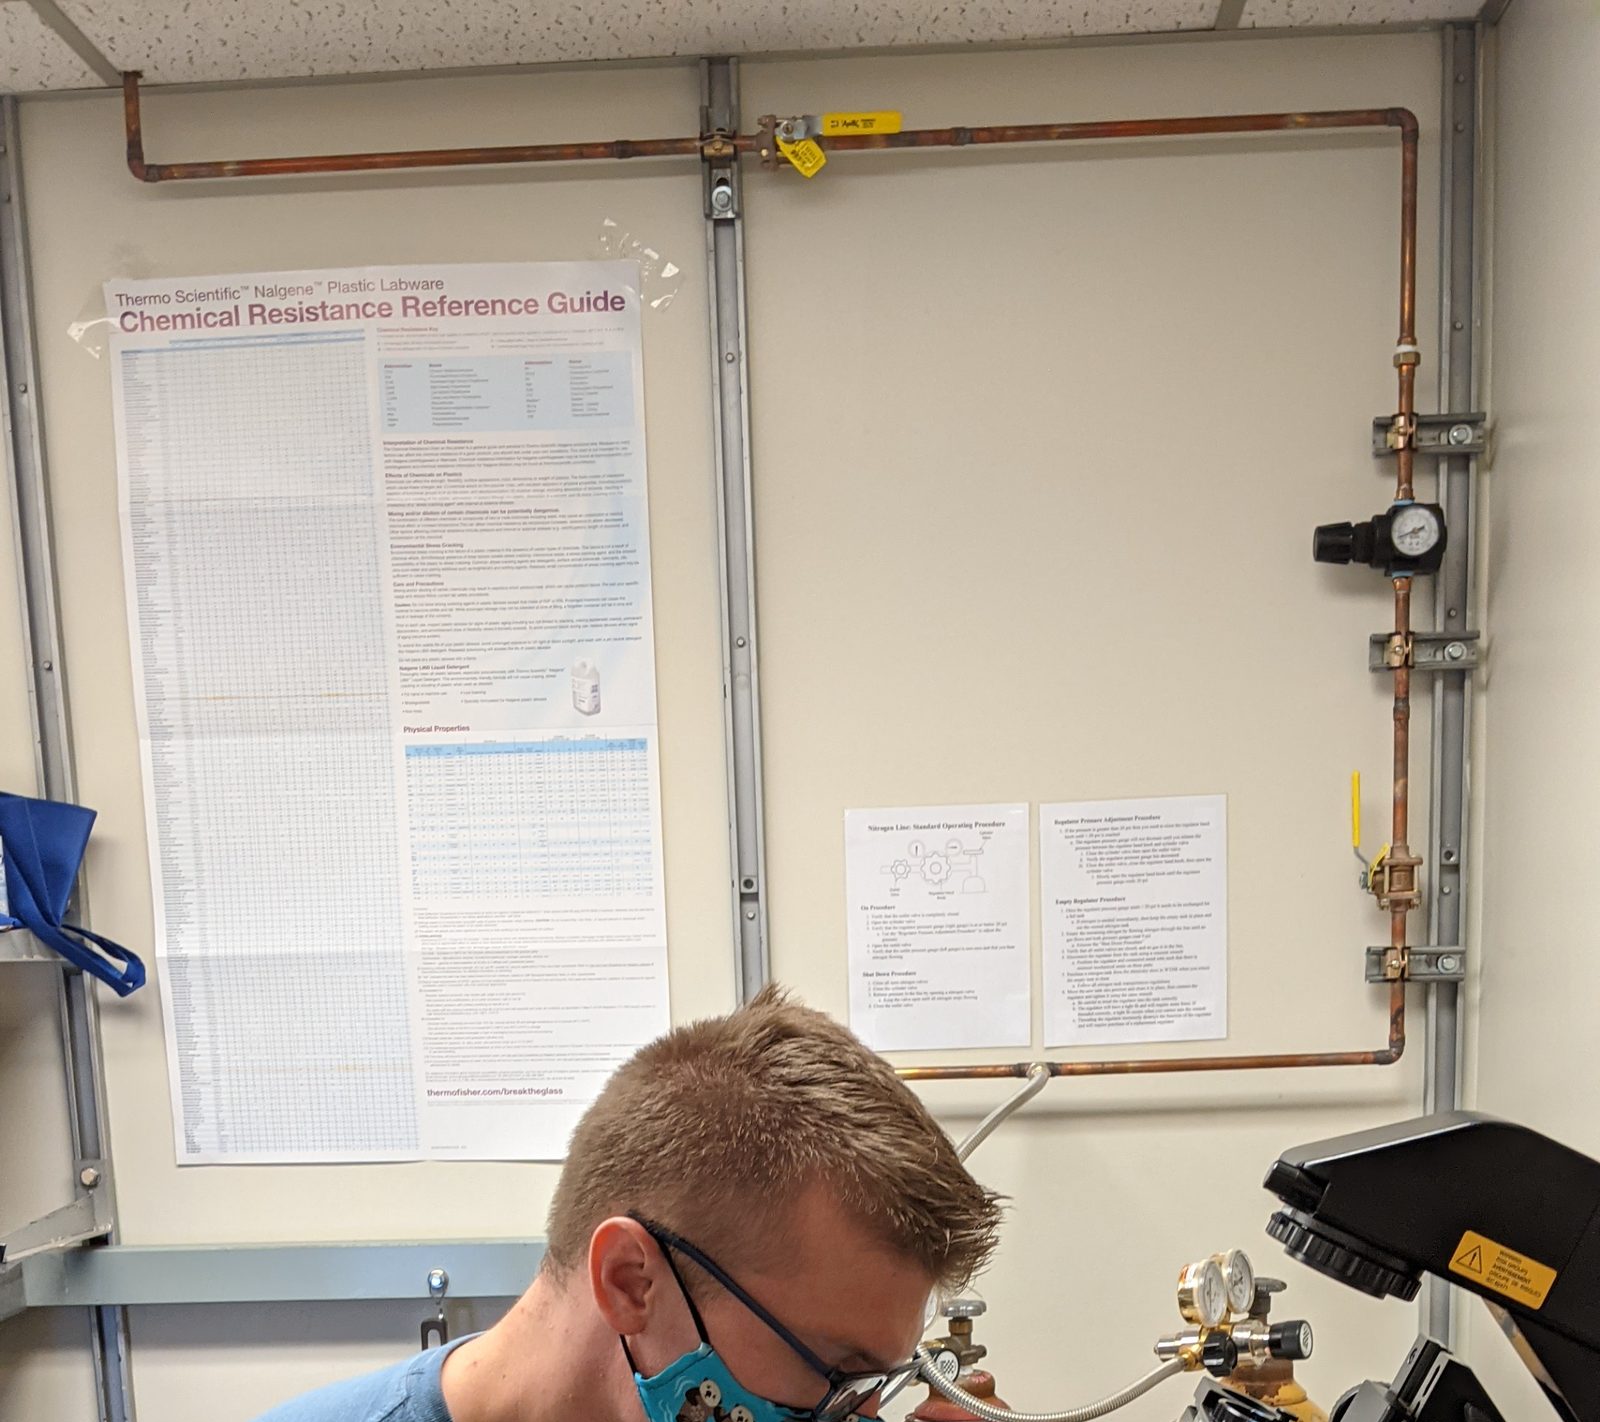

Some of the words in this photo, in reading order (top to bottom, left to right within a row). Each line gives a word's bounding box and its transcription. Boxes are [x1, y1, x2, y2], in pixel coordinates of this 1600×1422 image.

[115, 293, 171, 307] Thermo
[328, 279, 375, 294] Plastic
[380, 278, 444, 291] Labware
[119, 304, 240, 333] Chemical
[248, 300, 393, 326] Resistance
[401, 295, 539, 318] Reference
[547, 290, 626, 314] Guide
[403, 725, 433, 734] Physical
[434, 724, 470, 733] Properties
[427, 1087, 563, 1097] thermofisher.com/breaktheglass
